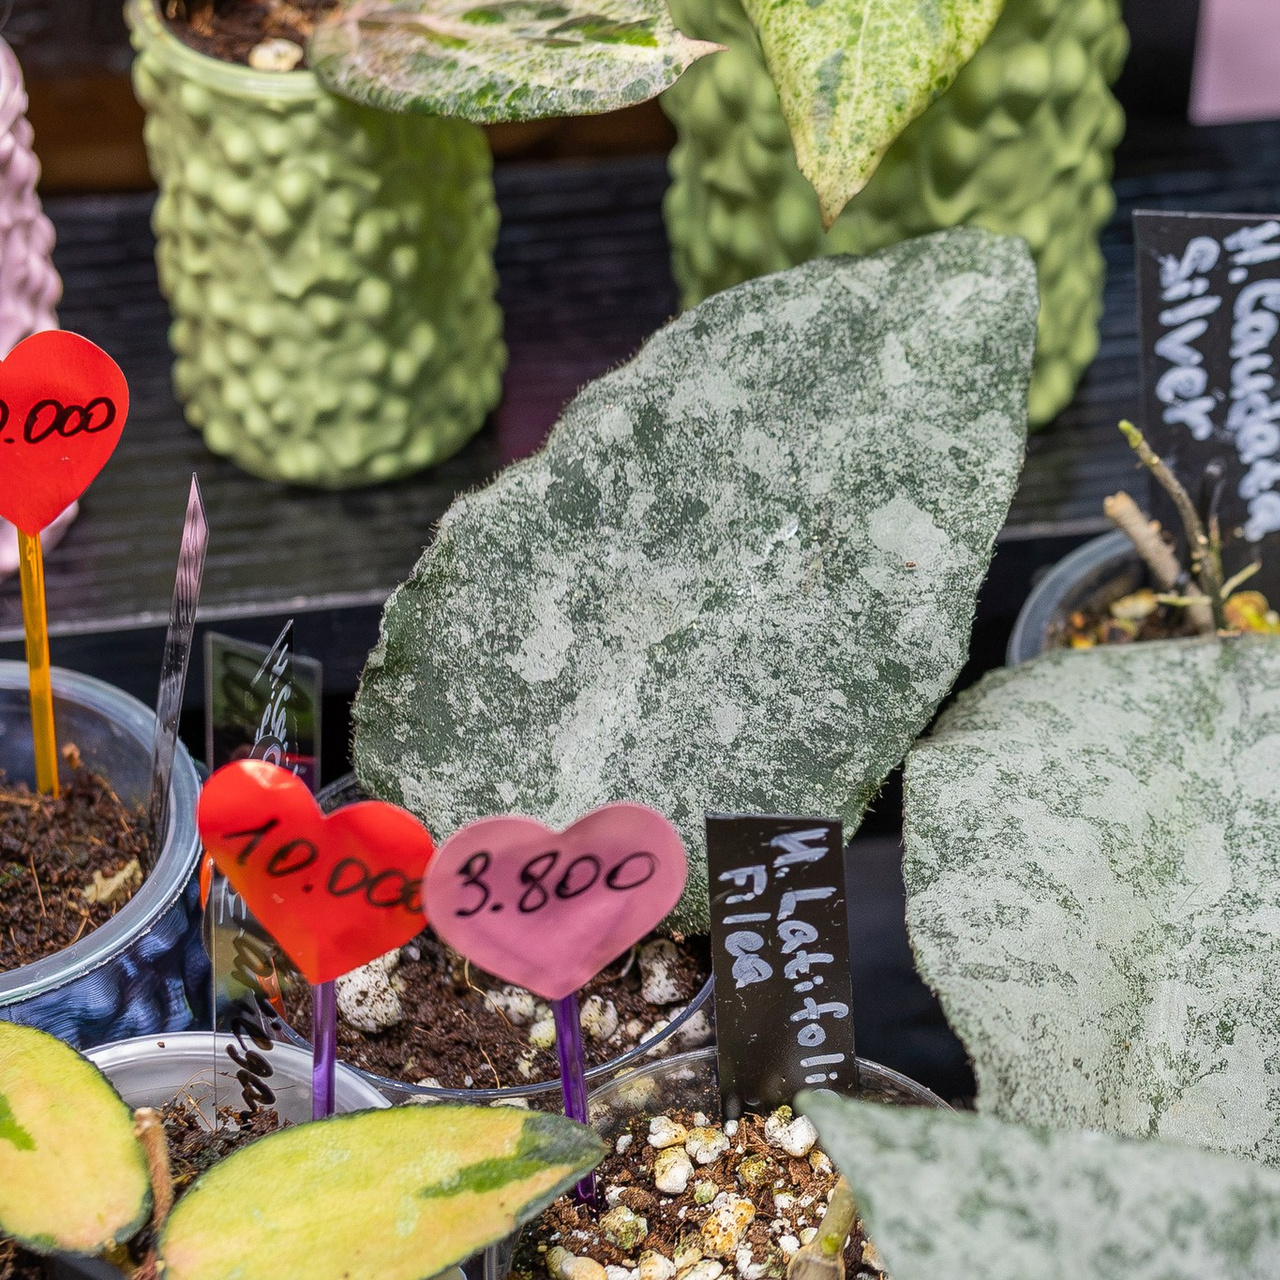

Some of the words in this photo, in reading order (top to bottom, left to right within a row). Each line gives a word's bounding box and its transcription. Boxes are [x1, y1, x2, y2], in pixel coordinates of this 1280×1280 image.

[1155, 235, 1222, 441] Silver
[454, 849, 660, 918] 3.800
[775, 885, 850, 1100] Latifoli
